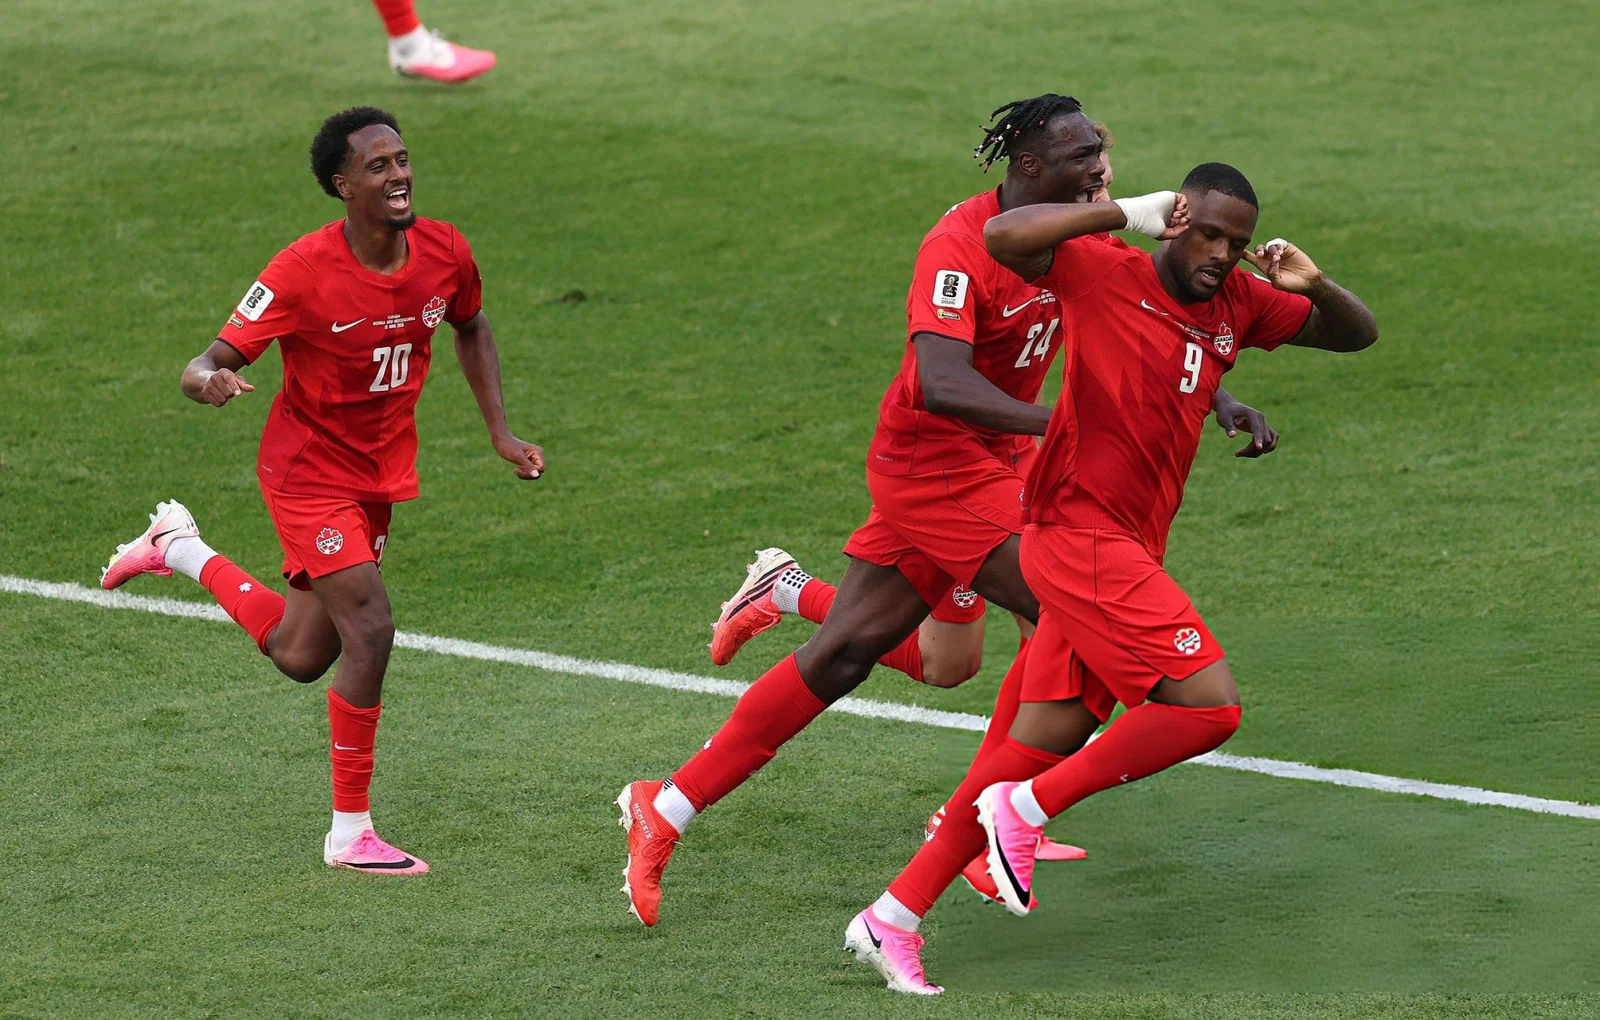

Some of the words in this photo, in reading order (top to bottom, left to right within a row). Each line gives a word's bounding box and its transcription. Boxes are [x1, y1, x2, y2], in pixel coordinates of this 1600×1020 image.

[424, 306, 445, 317] CANADA
[1014, 317, 1059, 368] 24
[369, 343, 412, 392] 20
[1180, 342, 1203, 394] 9
[318, 535, 342, 547] CANADA
